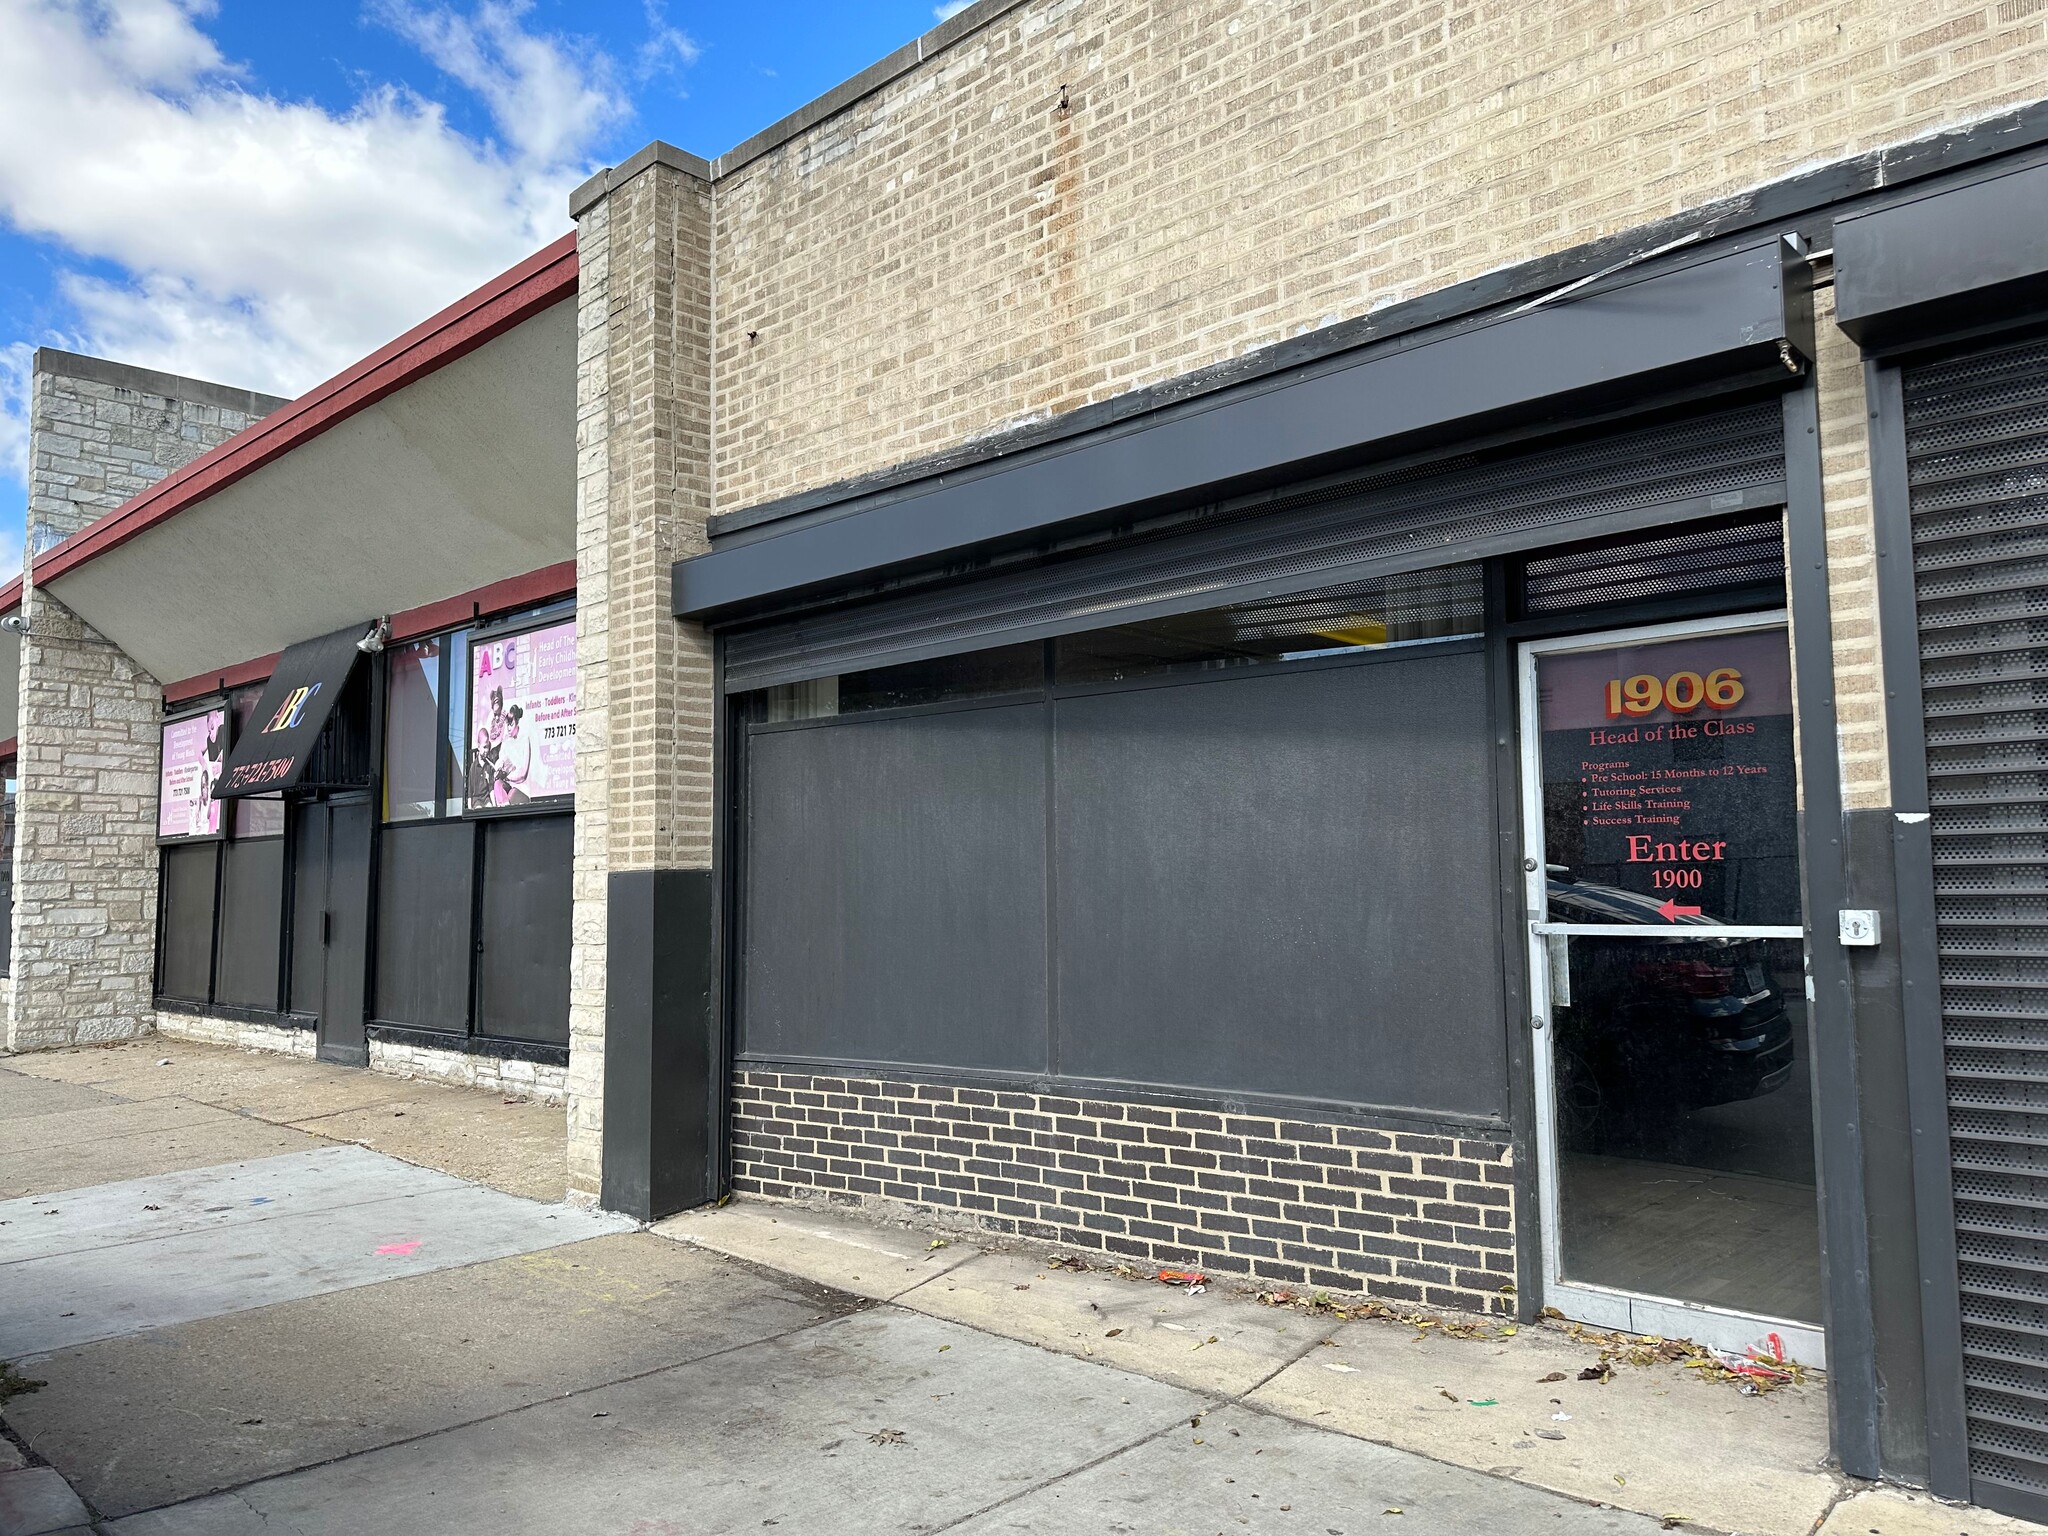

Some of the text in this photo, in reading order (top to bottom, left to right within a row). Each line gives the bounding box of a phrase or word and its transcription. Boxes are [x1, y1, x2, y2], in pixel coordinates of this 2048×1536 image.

[540, 635, 575, 651] Head of The
[479, 641, 515, 678] ABC
[539, 654, 554, 669] Early
[545, 695, 565, 706] Toddlers
[1605, 668, 1744, 719] 1906
[261, 682, 322, 734] ABC
[535, 712, 550, 722] Before
[551, 710, 560, 720] and
[561, 708, 573, 718] After
[545, 724, 576, 739] 773 721 75
[1589, 720, 1755, 746] Head of the Class
[225, 756, 294, 788] 773-721-7500
[1582, 760, 1630, 772] Programs
[1591, 764, 1767, 783] Pre School: 15 Months to 12 Years
[1592, 785, 1682, 798] Tutoring Services
[1592, 799, 1691, 811] Life Skills Training
[1592, 814, 1680, 826] Success Training
[1625, 835, 1727, 862] Enter
[1652, 869, 1702, 889] 1900
